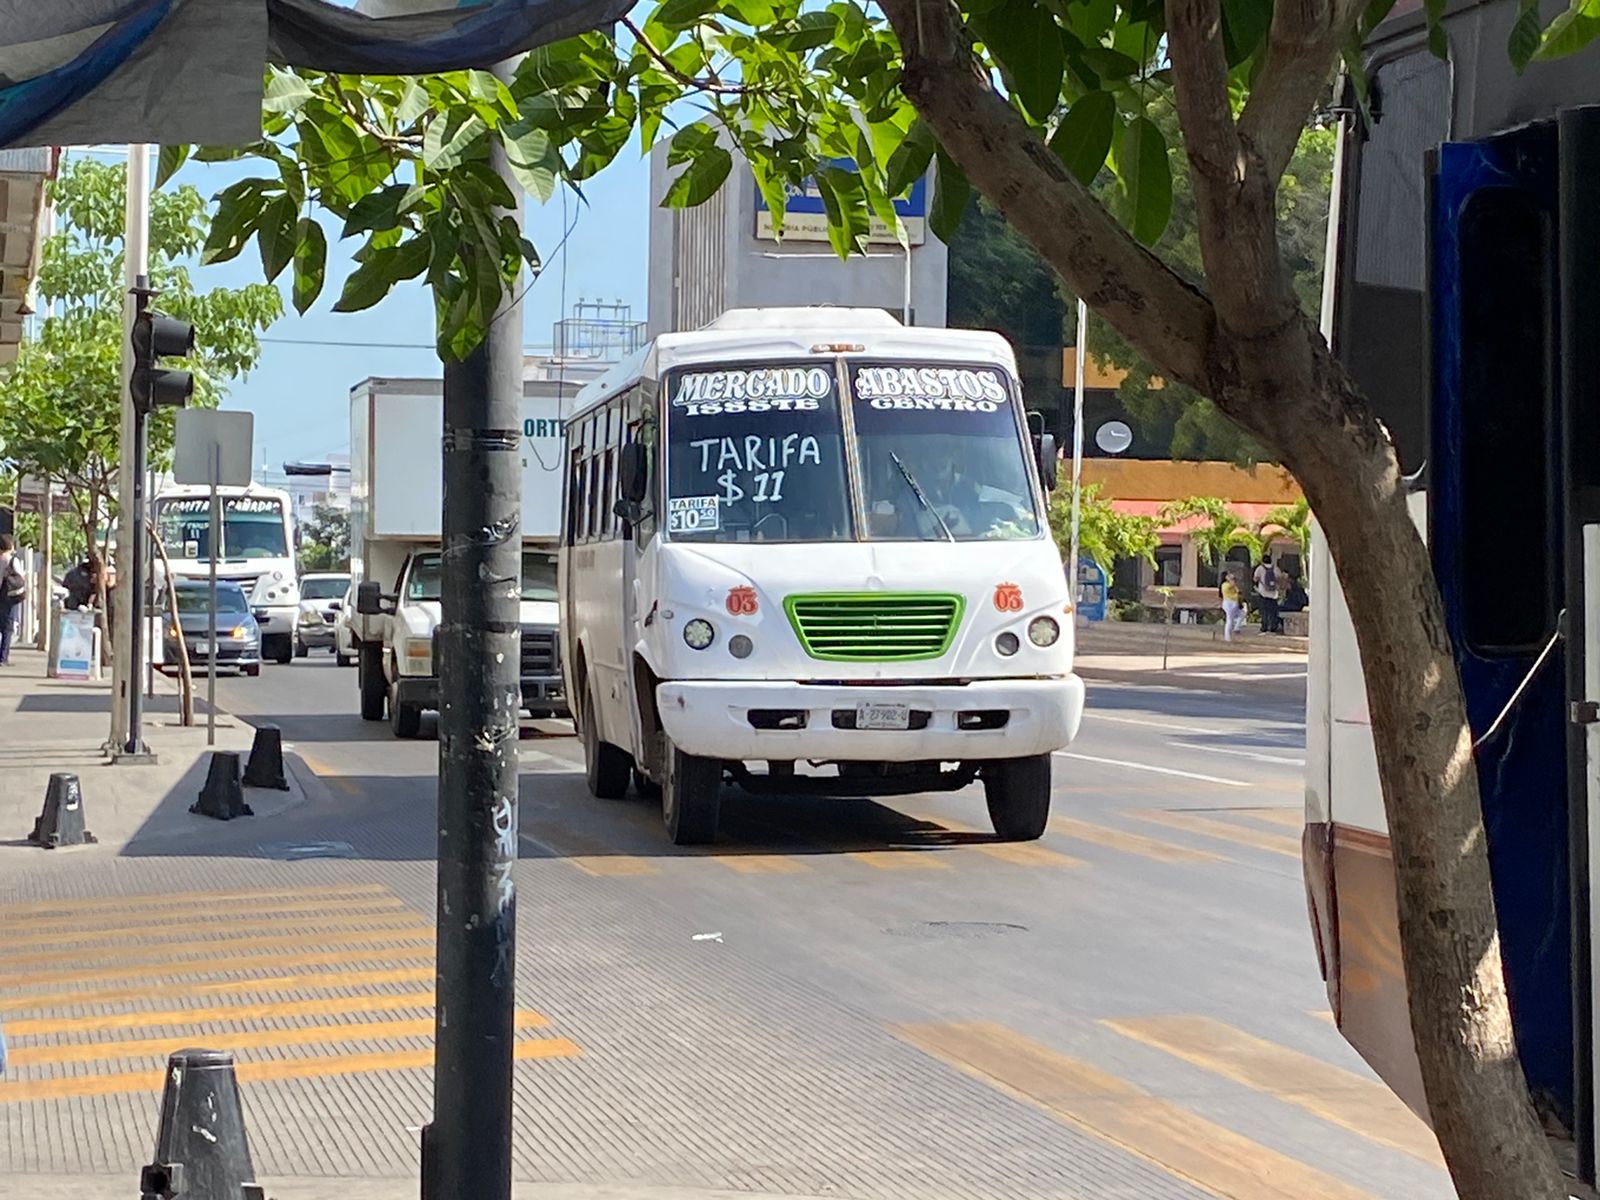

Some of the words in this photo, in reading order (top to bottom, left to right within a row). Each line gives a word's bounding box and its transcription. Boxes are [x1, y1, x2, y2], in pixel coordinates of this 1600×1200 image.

[673, 368, 831, 406] MERCADO
[855, 367, 1007, 403] ABASTOS
[686, 397, 820, 416] ISSSTE
[870, 396, 998, 413] CENTRO
[690, 433, 821, 473] TARIFA
[671, 498, 716, 509] TARIFA
[726, 590, 759, 617] 03
[993, 588, 1024, 614] 03
